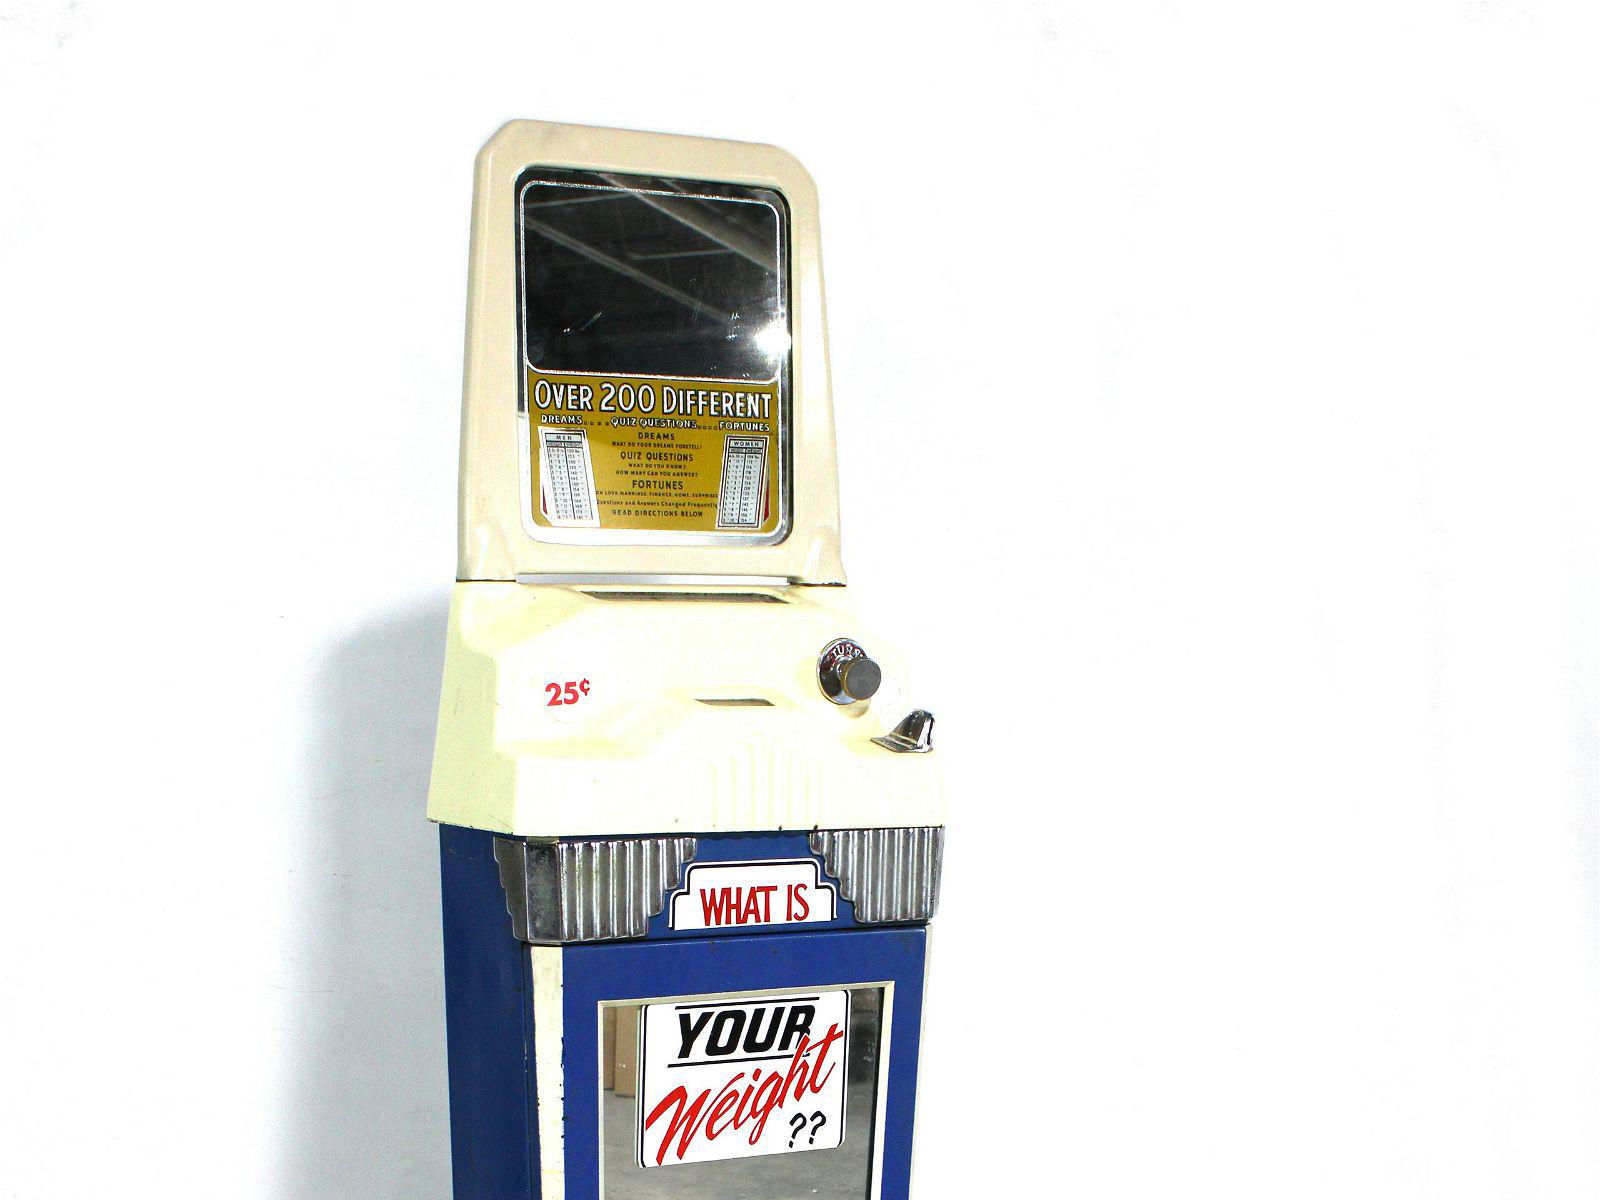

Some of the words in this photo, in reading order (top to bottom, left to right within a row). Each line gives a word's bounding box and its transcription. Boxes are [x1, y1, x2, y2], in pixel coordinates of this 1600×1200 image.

[534, 379, 594, 411] OVER
[600, 382, 656, 414] 200
[662, 386, 772, 419] DIFFERENT
[610, 416, 637, 428] QUIZ
[638, 417, 698, 430] QUESTIONS
[718, 421, 770, 432] FORTUNES
[638, 431, 675, 440] DREAMS
[620, 451, 642, 460] QUIZ
[646, 452, 693, 461] QUESTIONS
[632, 480, 684, 490] FORTUNES
[545, 678, 590, 707] 25¢
[699, 885, 778, 927] WHAT
[786, 883, 810, 922] IS
[677, 1004, 816, 1060] YOUR
[645, 1022, 844, 1166] Weight
